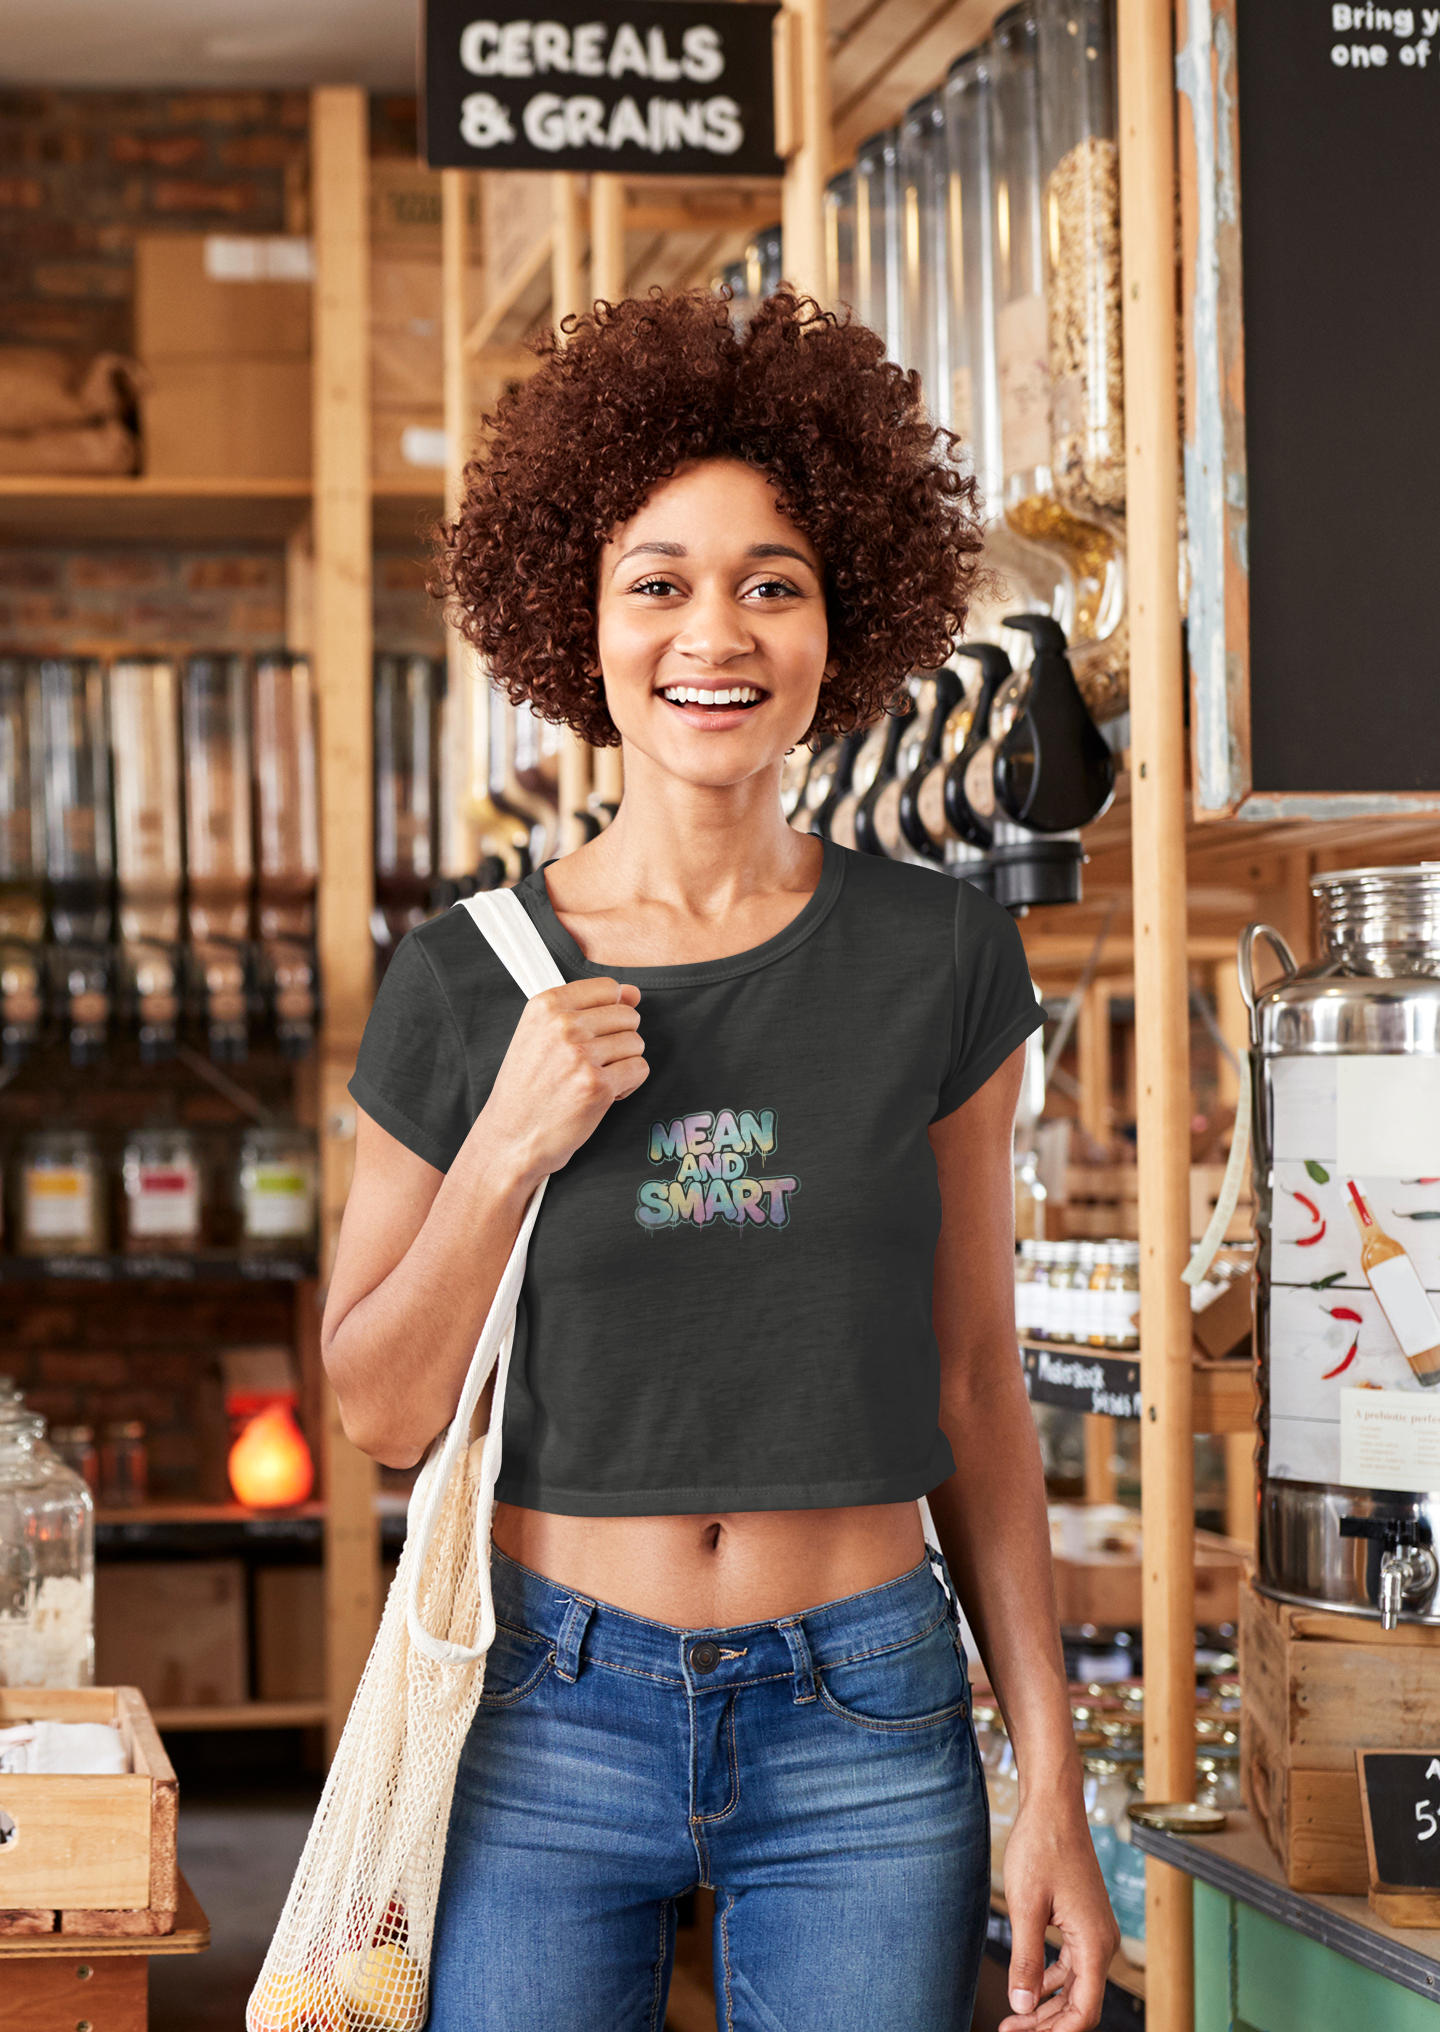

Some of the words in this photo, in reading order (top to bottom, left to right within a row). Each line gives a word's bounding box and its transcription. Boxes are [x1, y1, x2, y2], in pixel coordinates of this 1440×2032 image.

[1332, 0, 1414, 38] Bring
[1421, 8, 1440, 38] y
[460, 20, 725, 83] CEREALS
[1331, 43, 1388, 68] one
[1399, 38, 1431, 69] of
[460, 92, 515, 148] &
[523, 92, 744, 154] GRAINS
[649, 1108, 777, 1165] MEAN
[677, 1152, 747, 1184] AND
[636, 1175, 800, 1231] SMART
